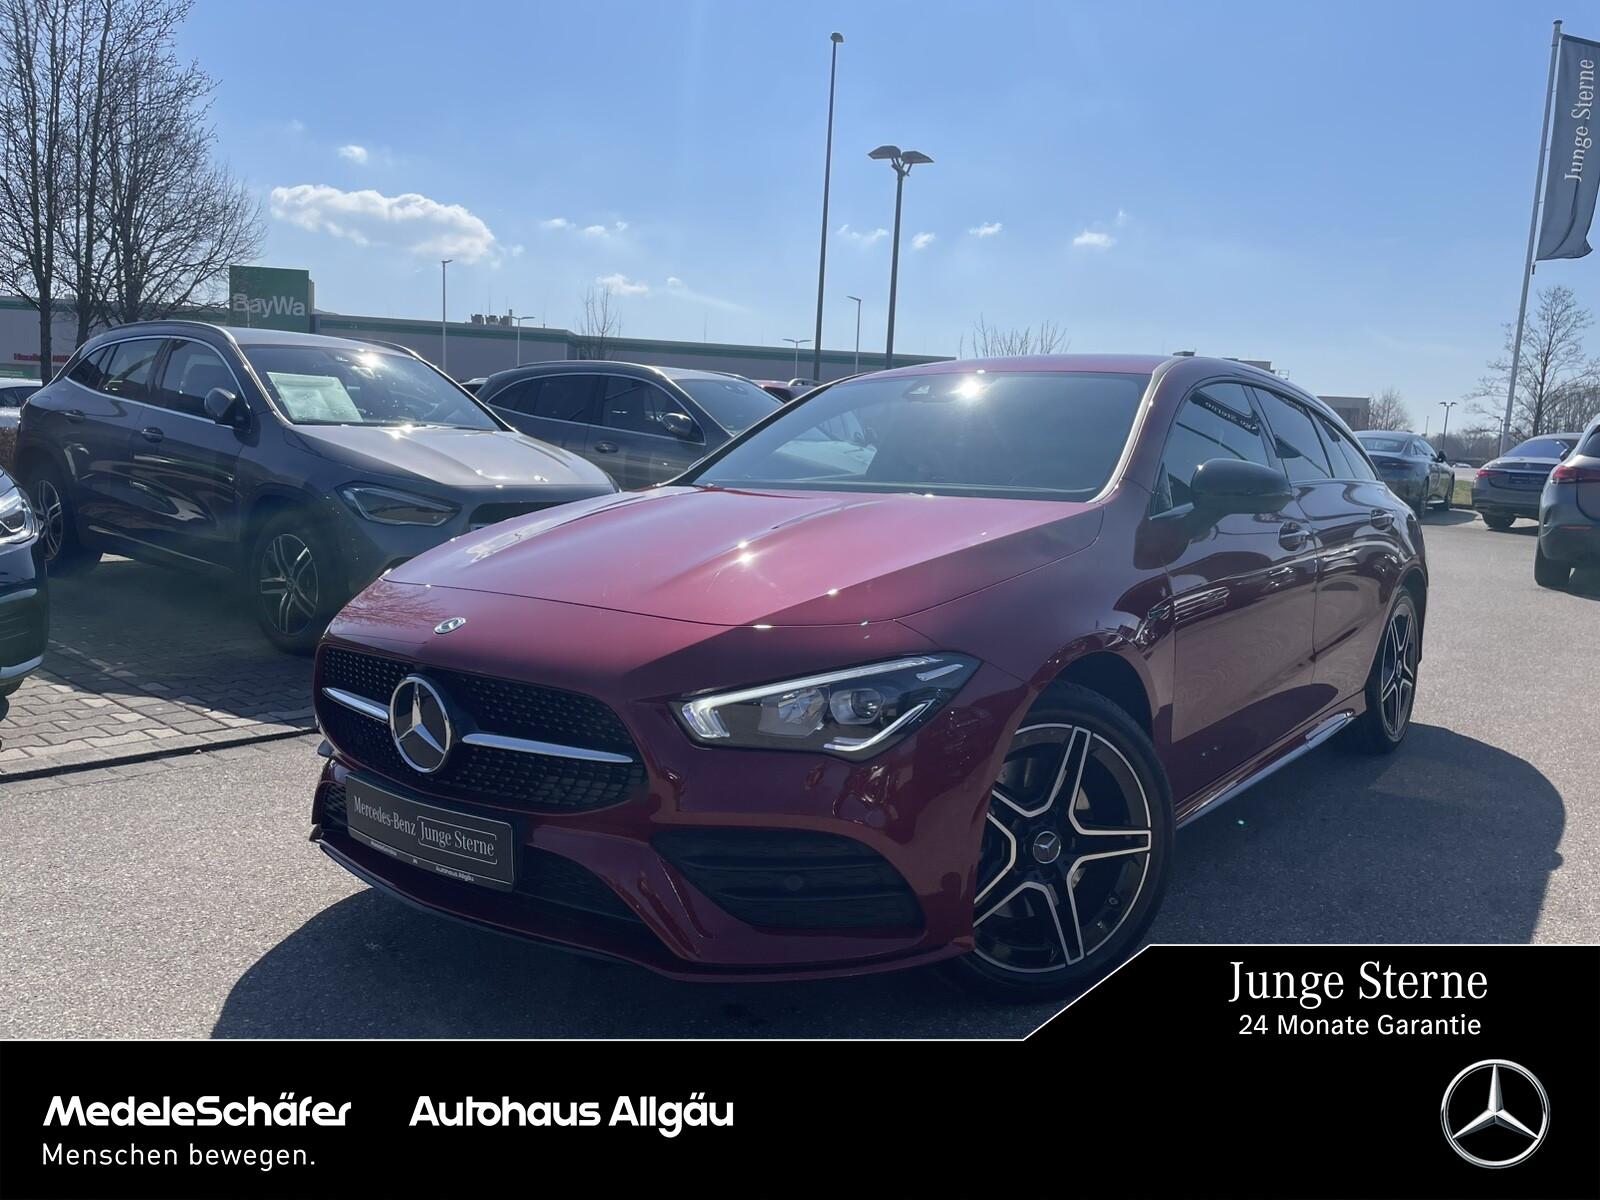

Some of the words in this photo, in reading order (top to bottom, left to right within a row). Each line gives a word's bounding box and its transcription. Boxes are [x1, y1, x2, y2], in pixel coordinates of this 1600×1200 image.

[1571, 59, 1595, 120] Sterne
[1564, 126, 1592, 183] Junge
[233, 293, 305, 318] BayWa
[354, 795, 416, 836] Mercedes-Benz
[420, 821, 452, 848] Junge
[454, 831, 495, 857] Sterne
